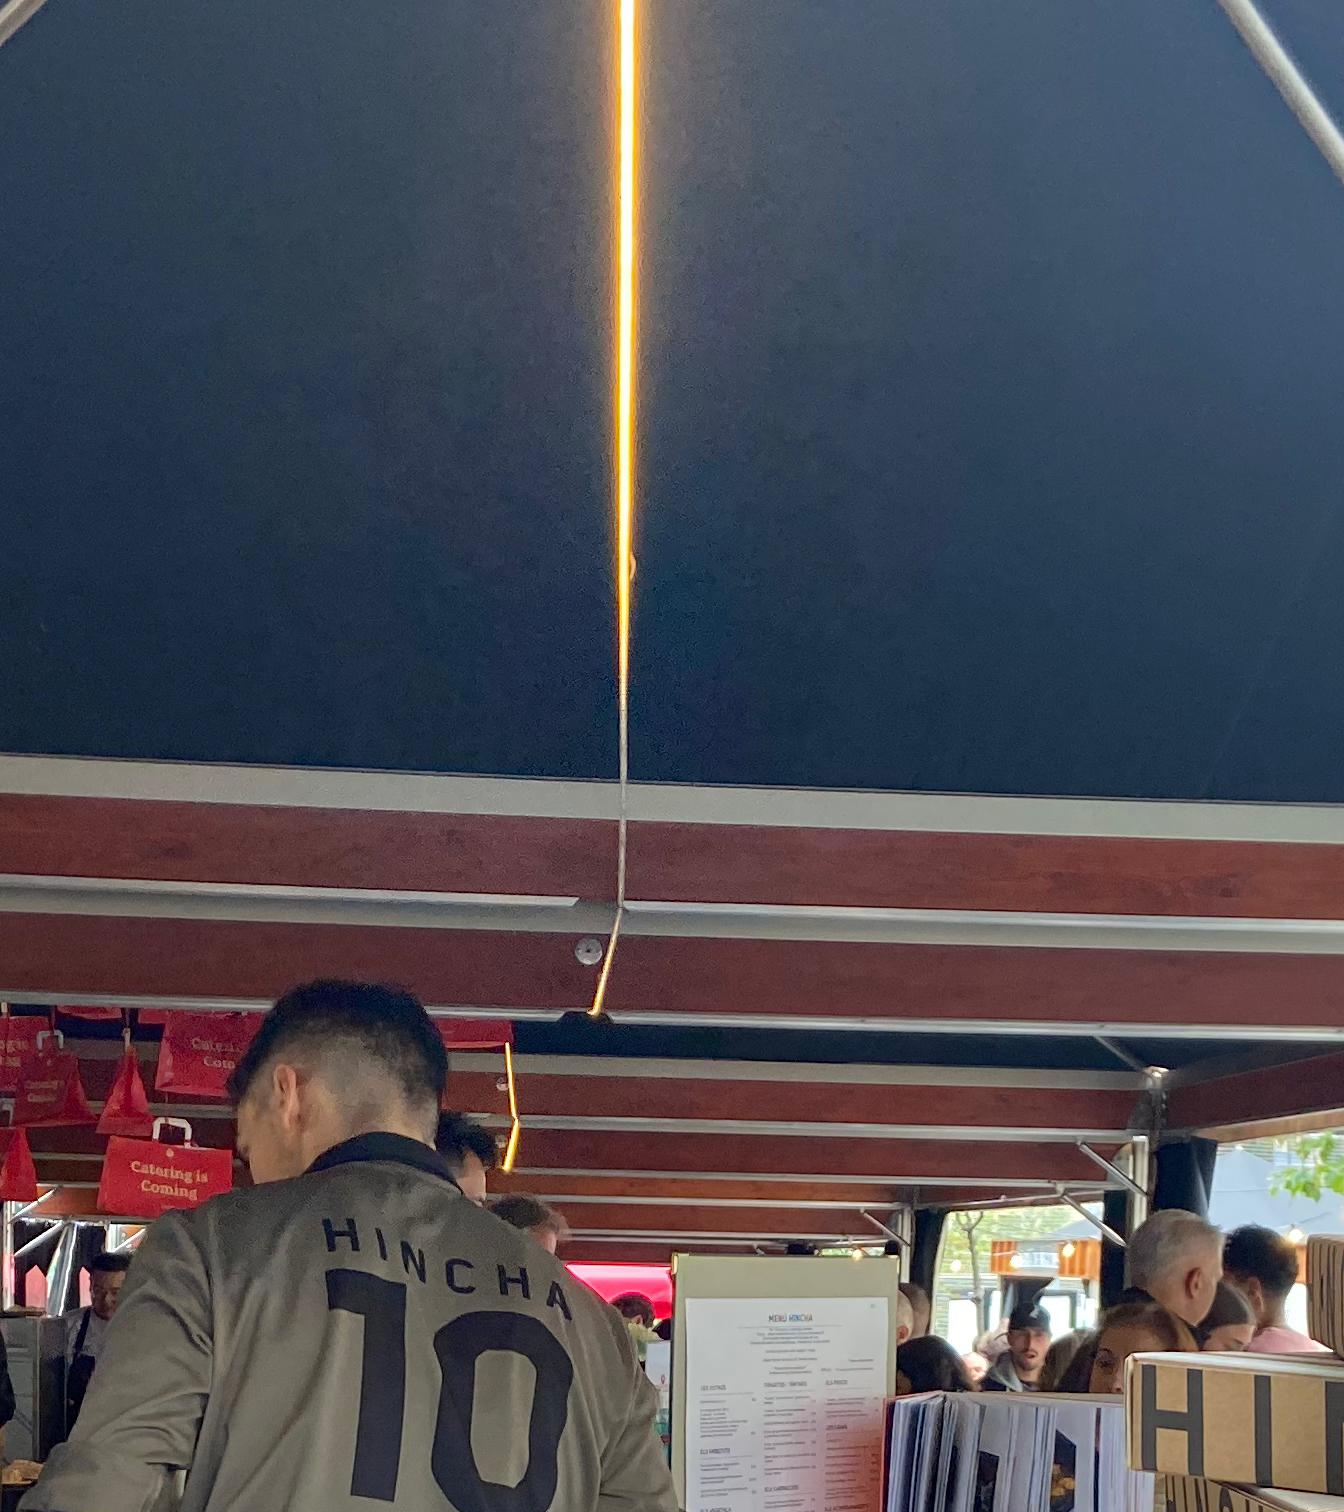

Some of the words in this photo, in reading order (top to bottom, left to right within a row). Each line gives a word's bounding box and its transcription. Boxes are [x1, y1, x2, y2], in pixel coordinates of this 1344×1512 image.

[130, 1160, 193, 1184] Catering
[195, 1168, 208, 1183] is
[141, 1179, 198, 1201] Coming
[322, 1218, 573, 1322] HINCHA
